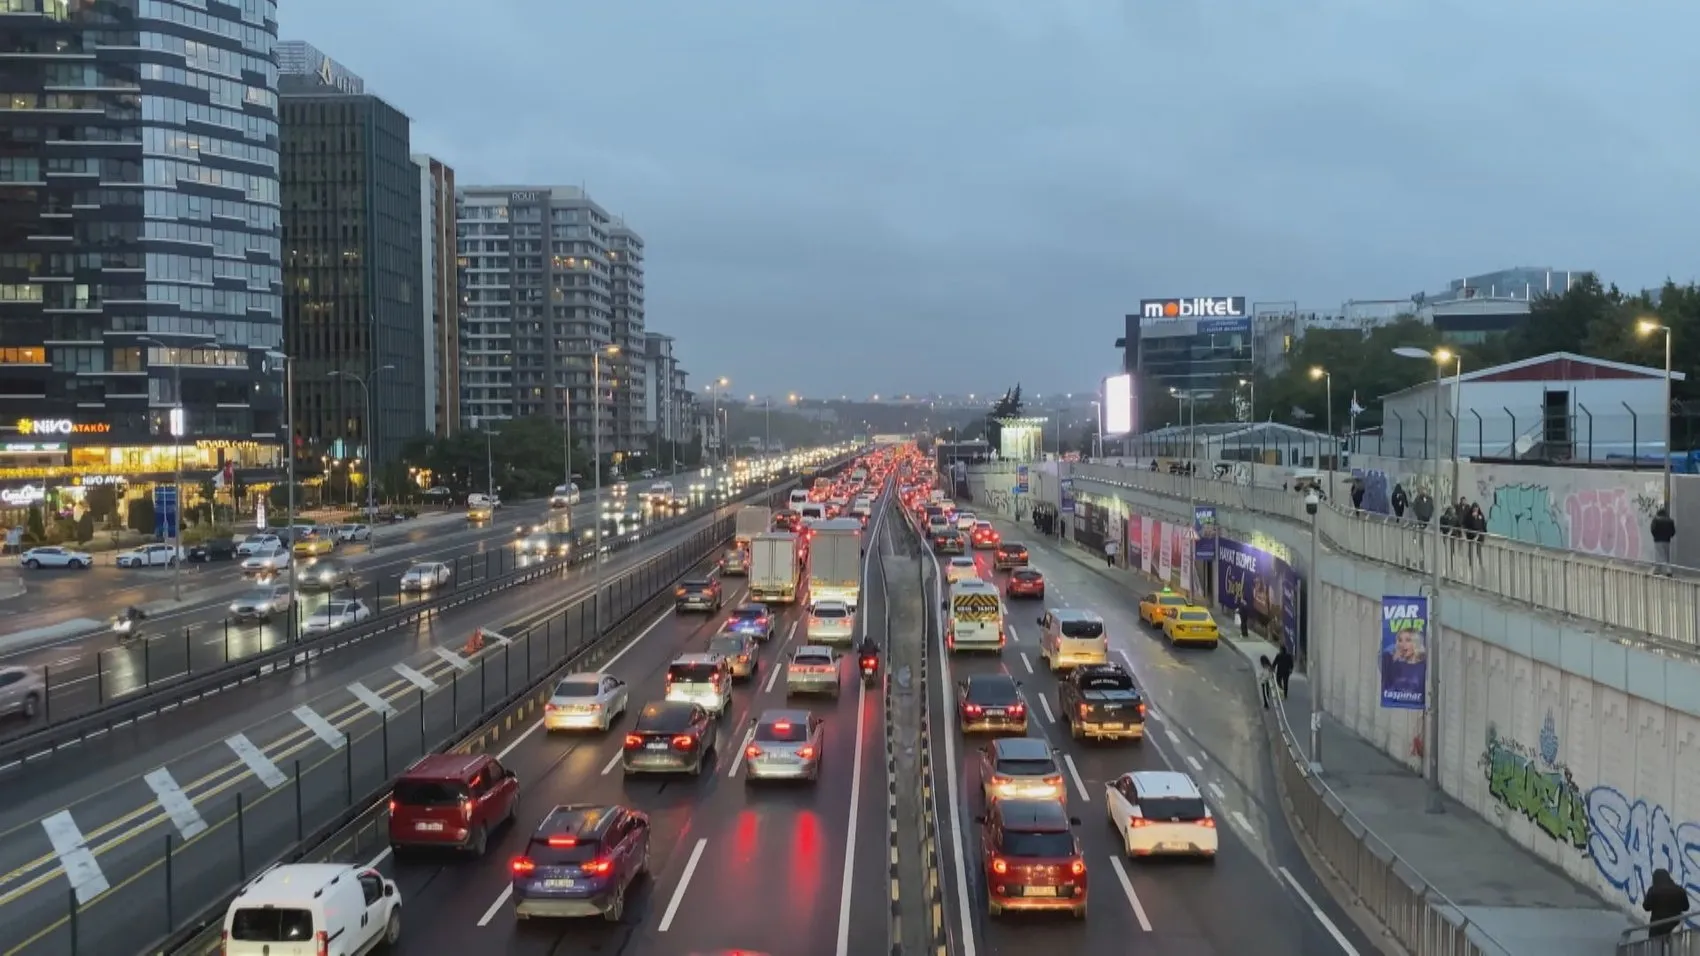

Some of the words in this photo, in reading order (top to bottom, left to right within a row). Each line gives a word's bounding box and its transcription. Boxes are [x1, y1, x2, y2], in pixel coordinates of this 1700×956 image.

[1219, 545, 1236, 565] HAYAT
[1383, 604, 1420, 620] VAR
[1389, 619, 1425, 633] VAR
